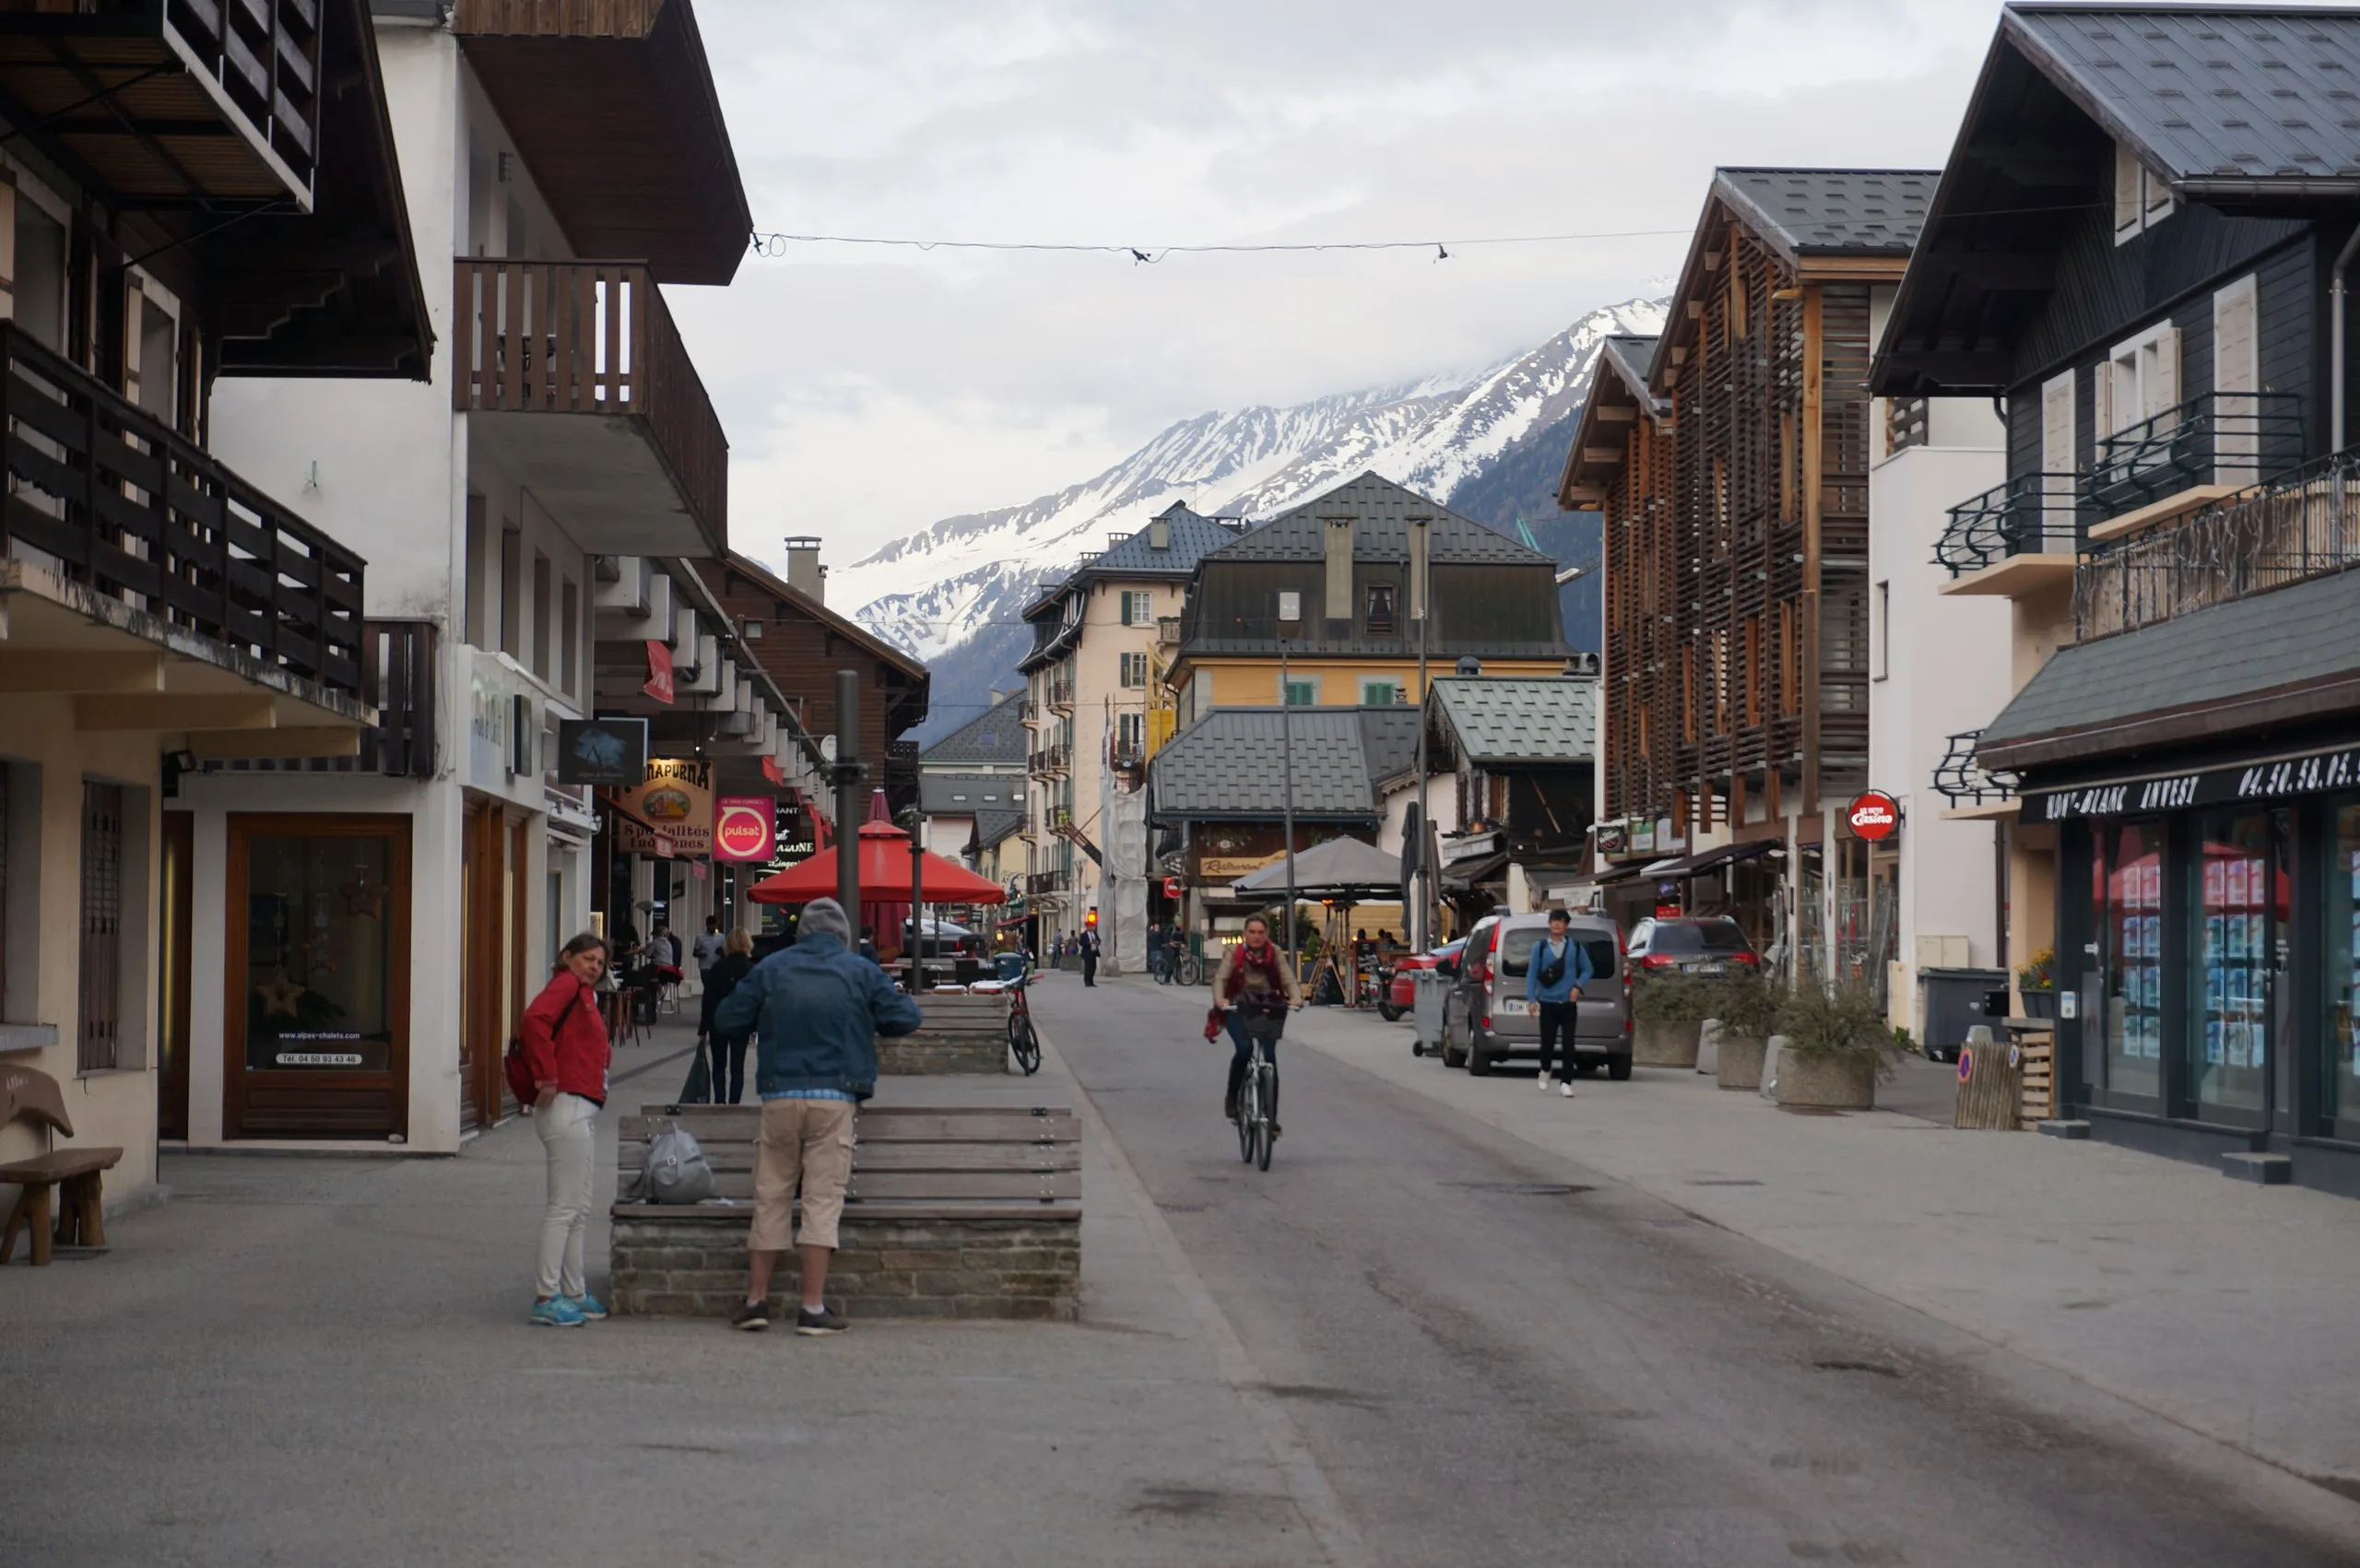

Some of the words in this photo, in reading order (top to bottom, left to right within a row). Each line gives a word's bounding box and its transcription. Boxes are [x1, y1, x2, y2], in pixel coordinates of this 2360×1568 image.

[643, 761, 711, 790] NAPURNA
[2140, 775, 2200, 809] INVEST
[625, 825, 710, 839] Spialités
[725, 826, 760, 838] pulsat
[631, 838, 704, 849] Indnnes
